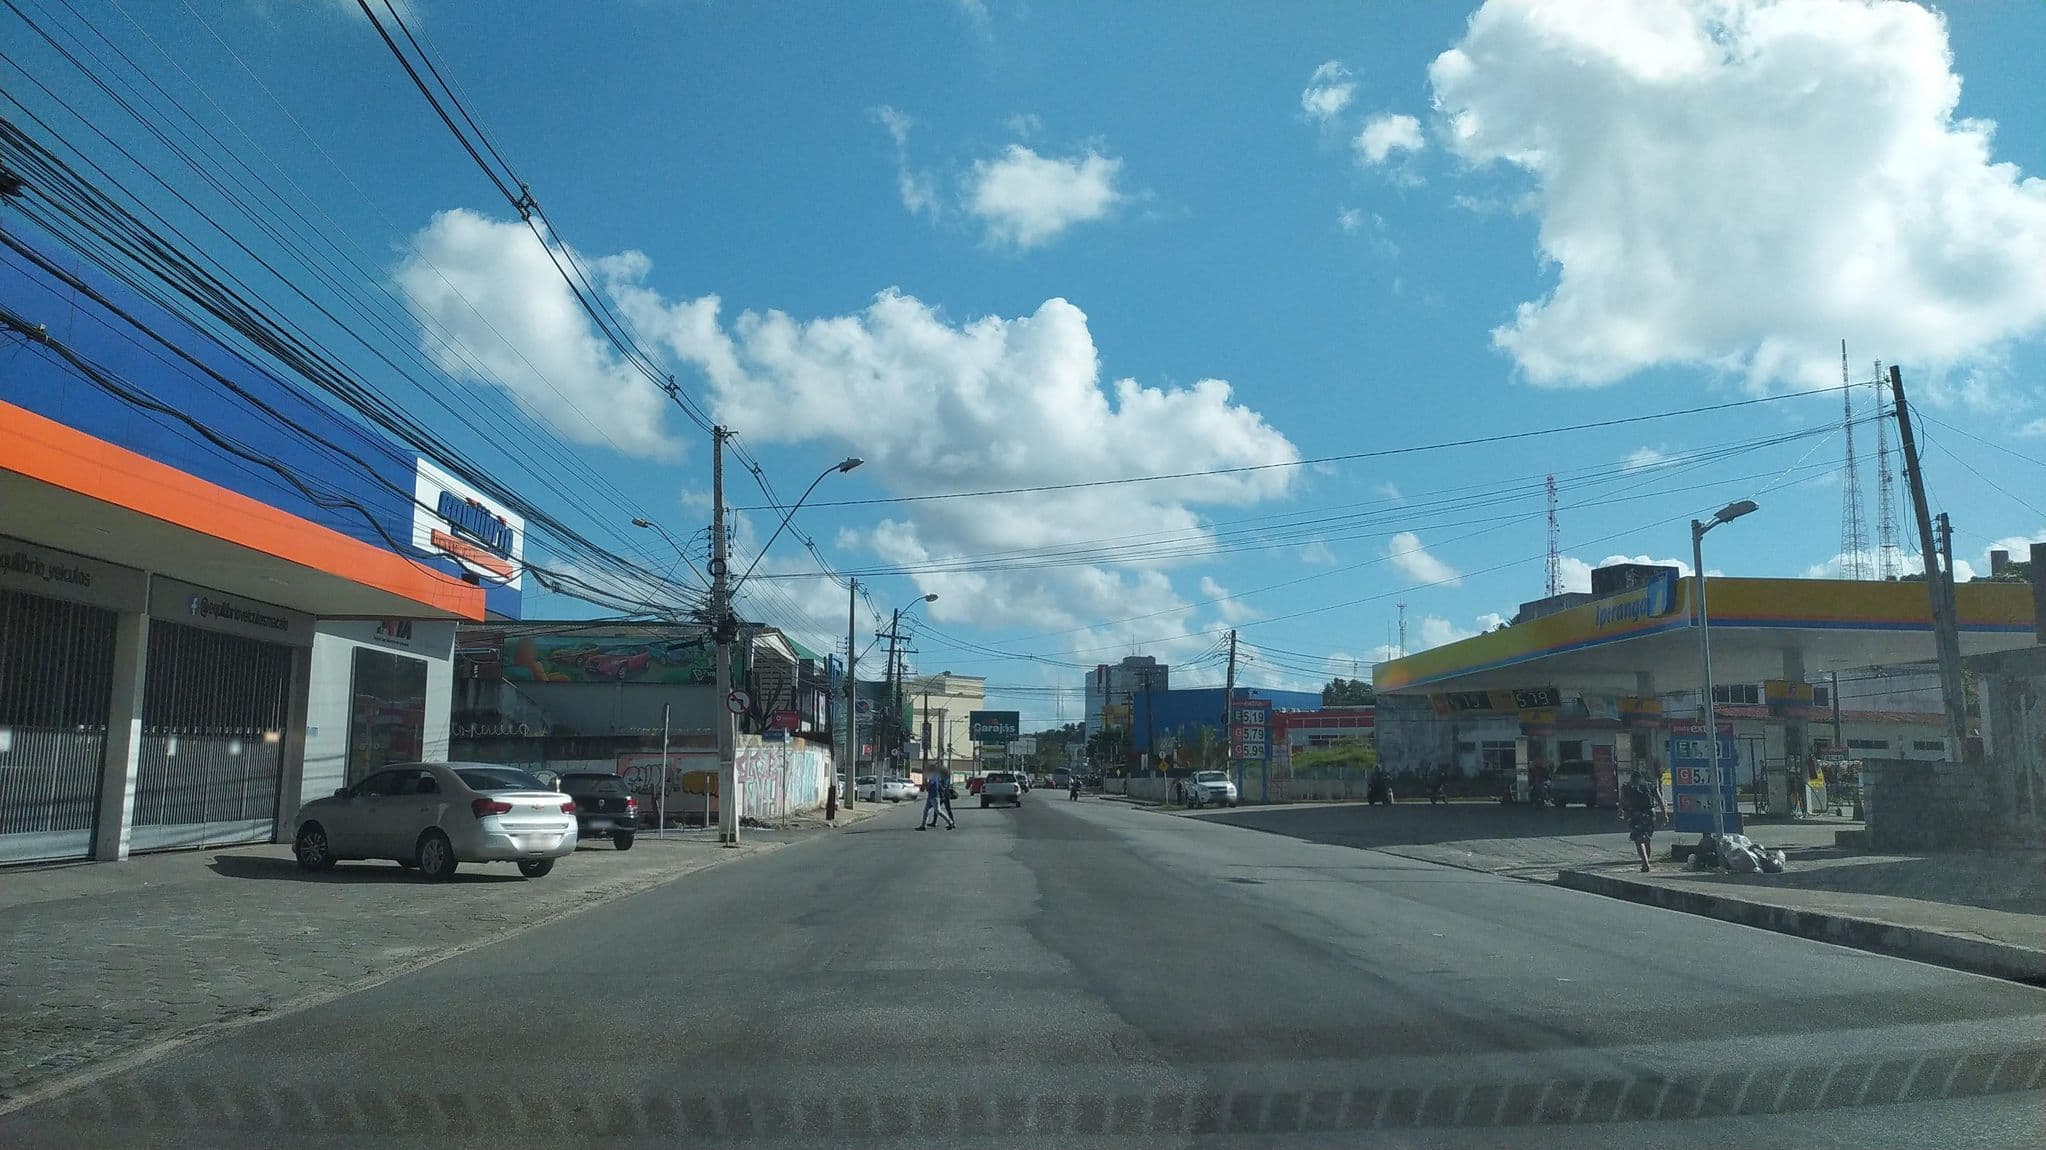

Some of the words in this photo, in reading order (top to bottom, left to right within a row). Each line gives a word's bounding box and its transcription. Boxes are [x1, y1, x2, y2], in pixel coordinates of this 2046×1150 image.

[1596, 598, 1648, 628] Ipiranga
[1243, 711, 1264, 723] 5,19
[1243, 728, 1264, 741] 5,79
